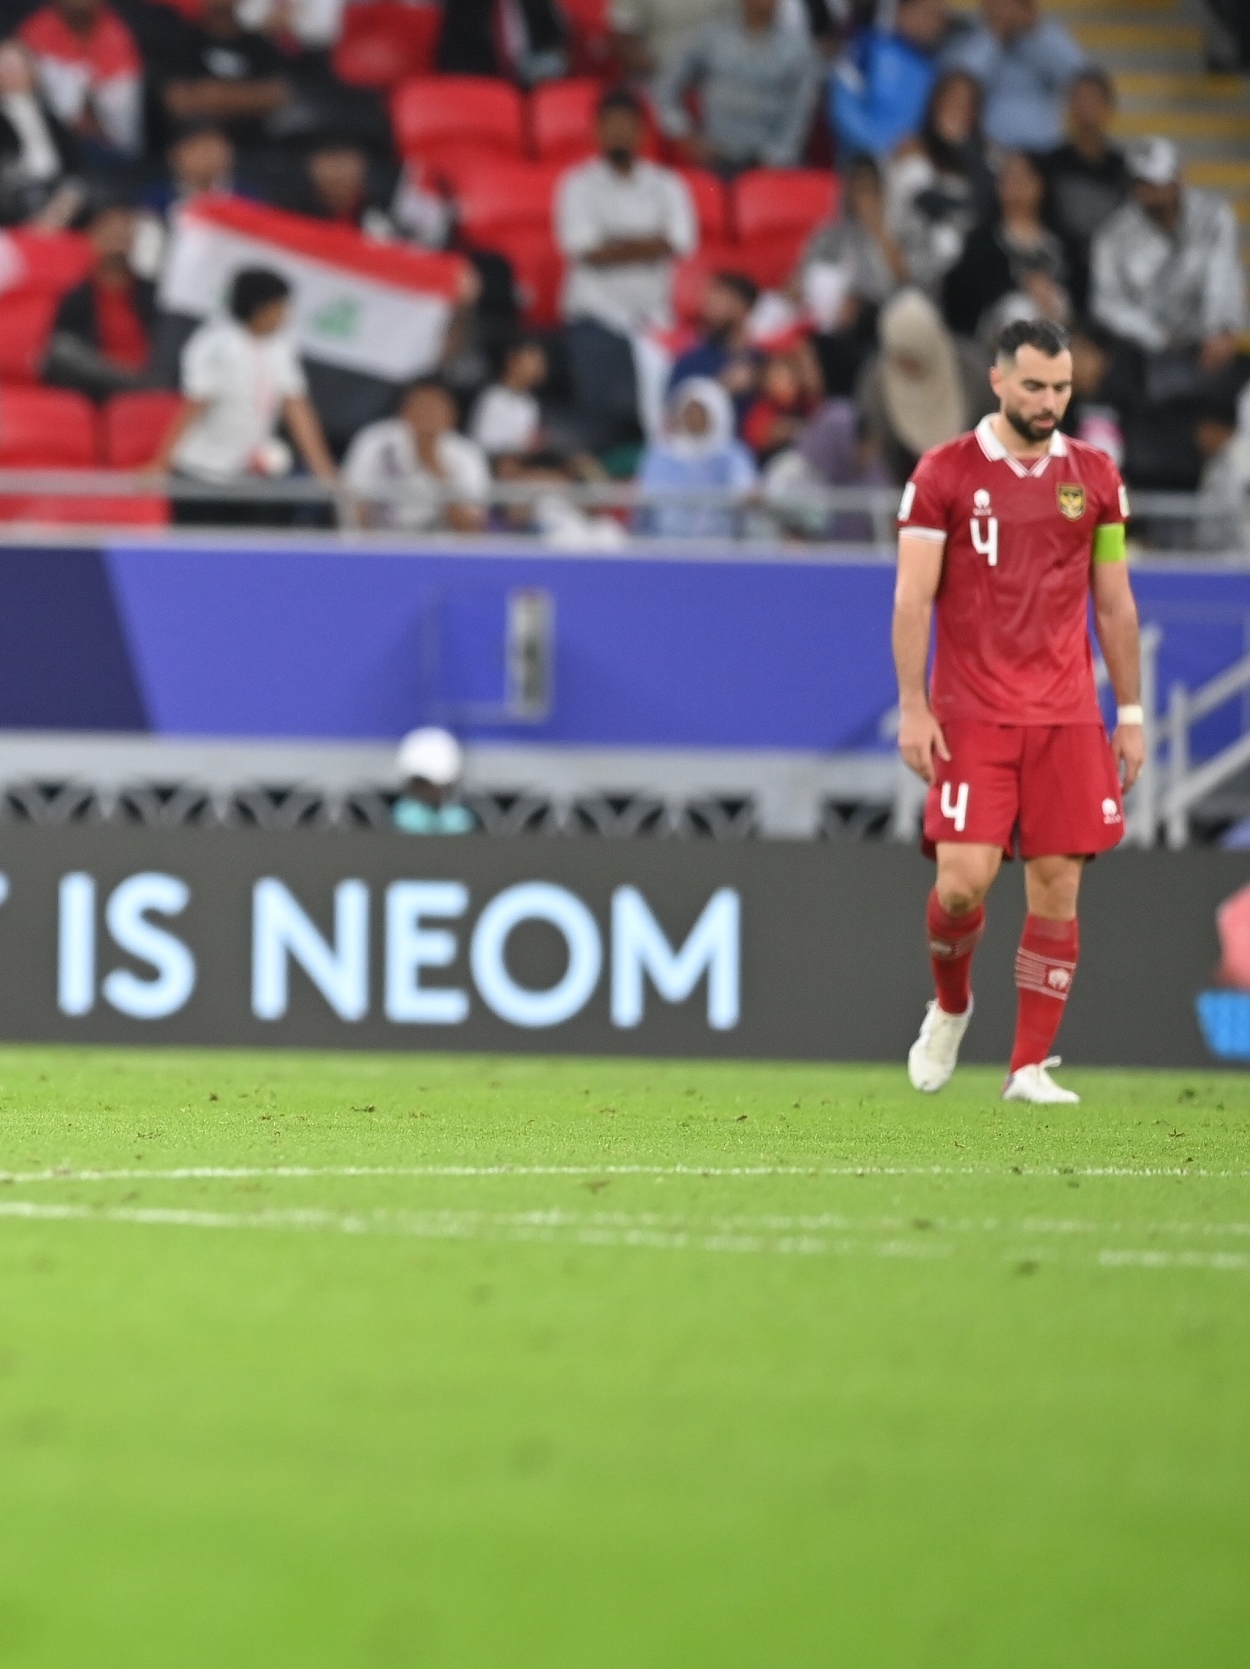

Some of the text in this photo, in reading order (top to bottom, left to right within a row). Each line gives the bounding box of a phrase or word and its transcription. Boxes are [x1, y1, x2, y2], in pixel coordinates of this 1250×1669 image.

[970, 517, 998, 567] 4
[940, 781, 969, 832] 4
[58, 872, 196, 1020] IS
[251, 876, 741, 1032] NEOM
